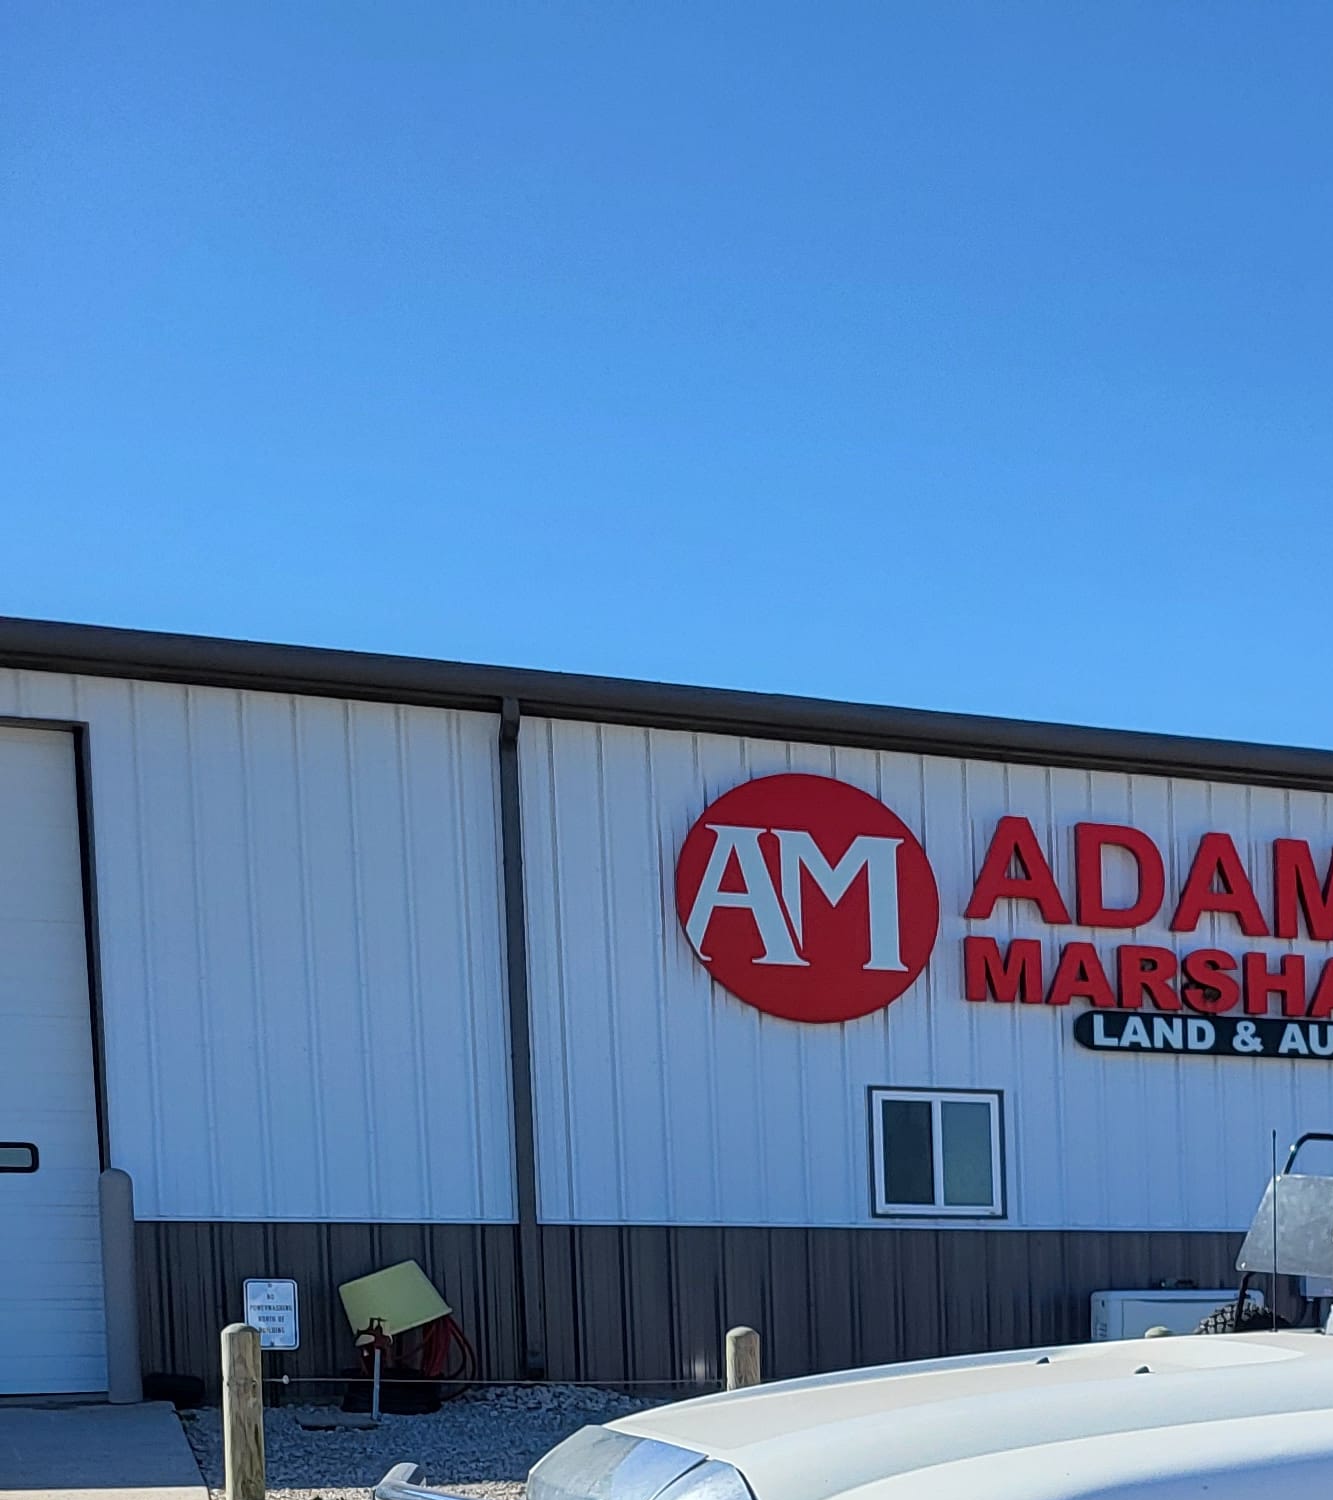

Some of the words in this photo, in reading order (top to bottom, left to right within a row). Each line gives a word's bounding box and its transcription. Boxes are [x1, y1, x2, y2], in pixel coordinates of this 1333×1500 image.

[685, 823, 910, 973] AM
[1093, 1013, 1216, 1052] LAND
[1232, 1021, 1264, 1055] &
